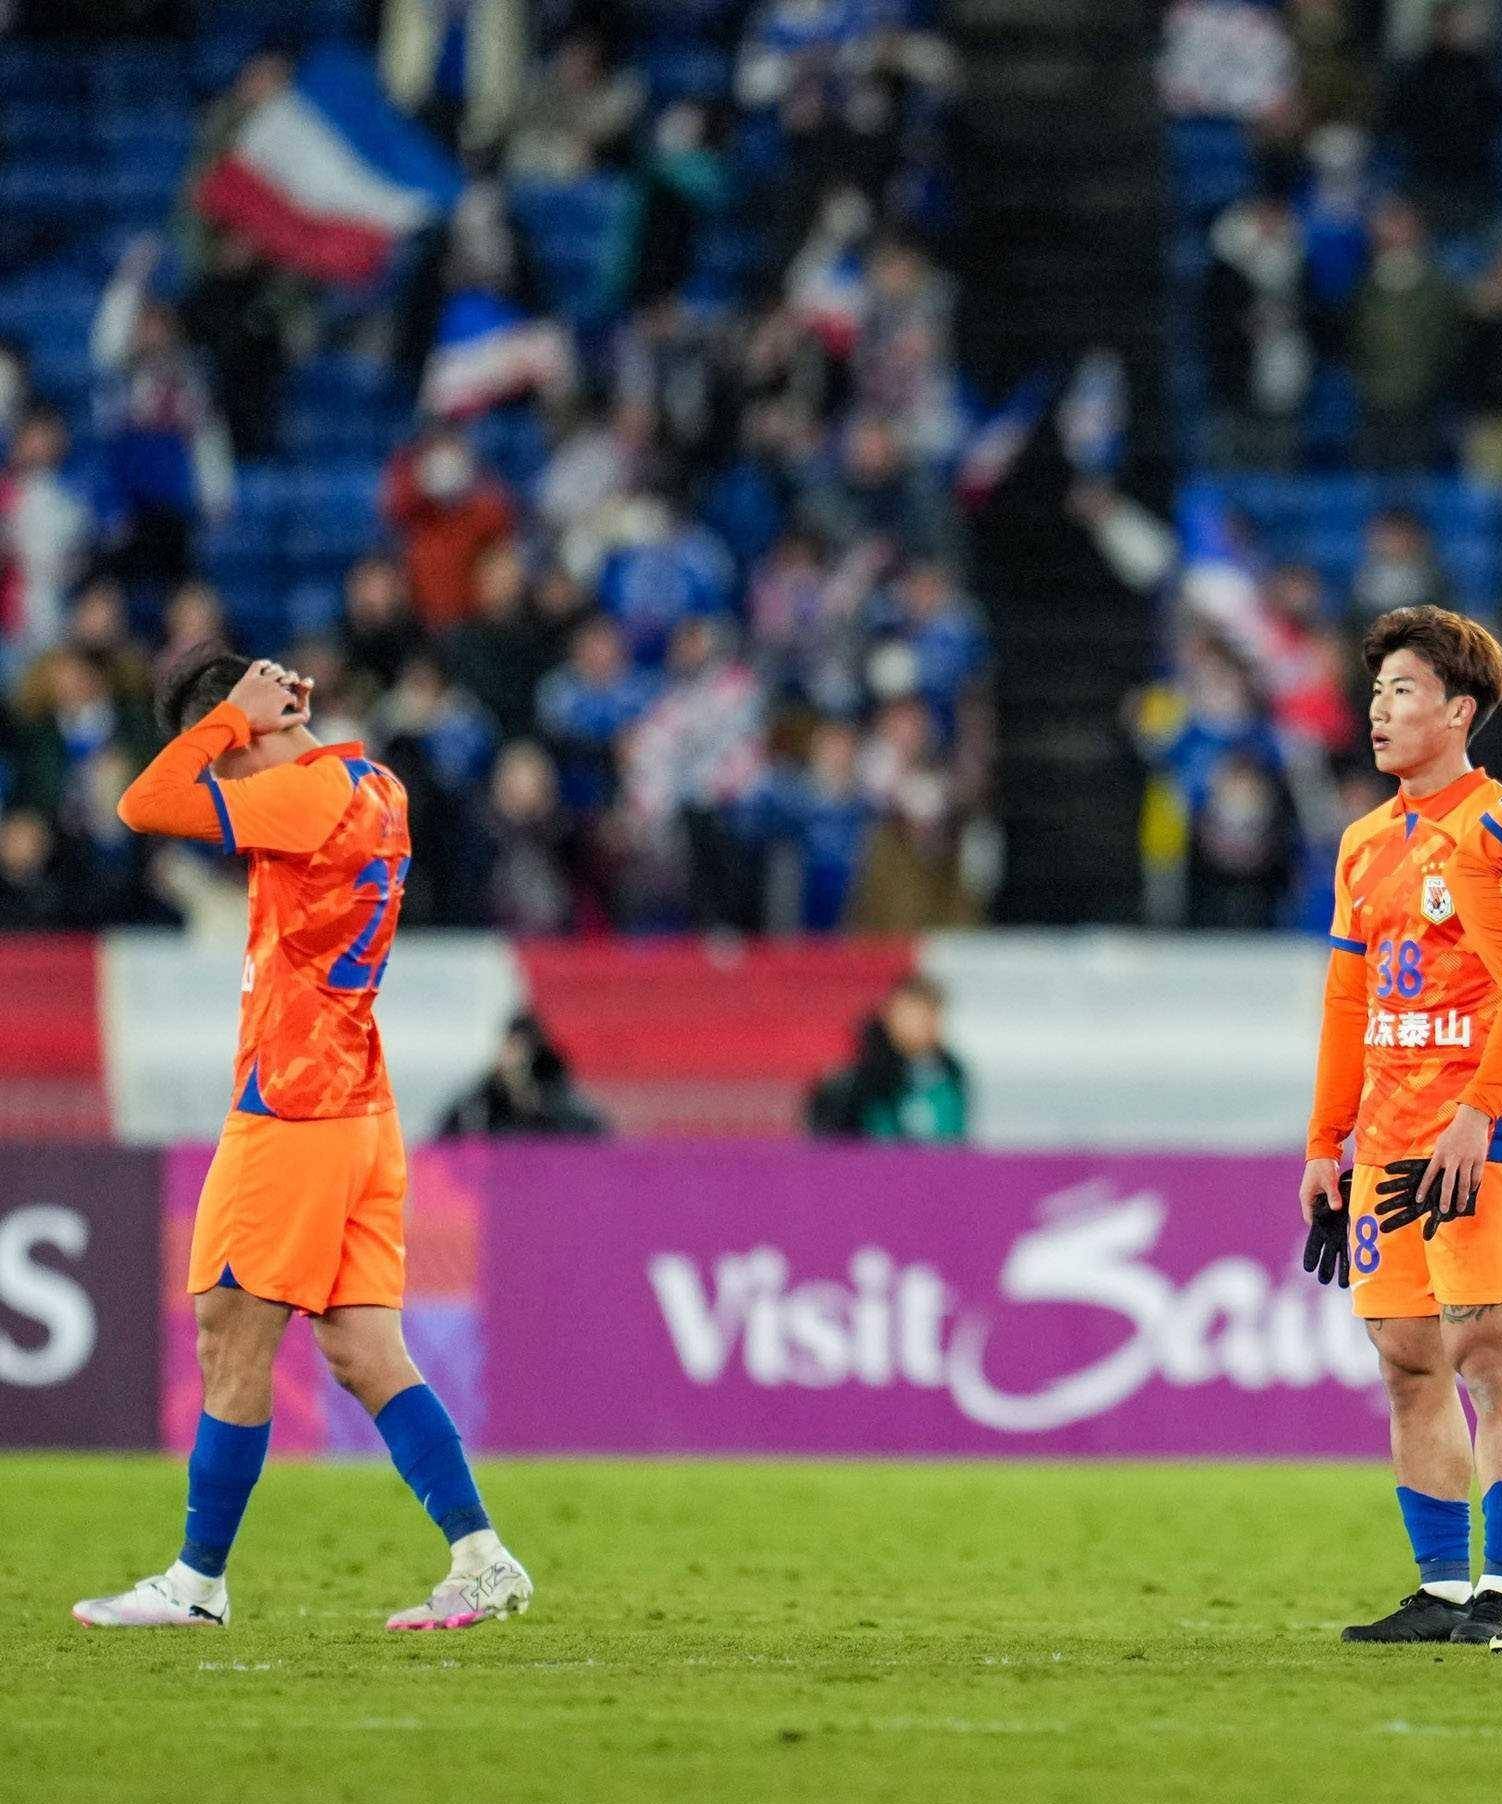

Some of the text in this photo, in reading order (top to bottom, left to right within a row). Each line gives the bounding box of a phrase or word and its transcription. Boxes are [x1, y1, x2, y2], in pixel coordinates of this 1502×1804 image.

[1376, 938, 1424, 999] 38
[1353, 1214, 1381, 1274] 8
[648, 1246, 948, 1388] Visit
